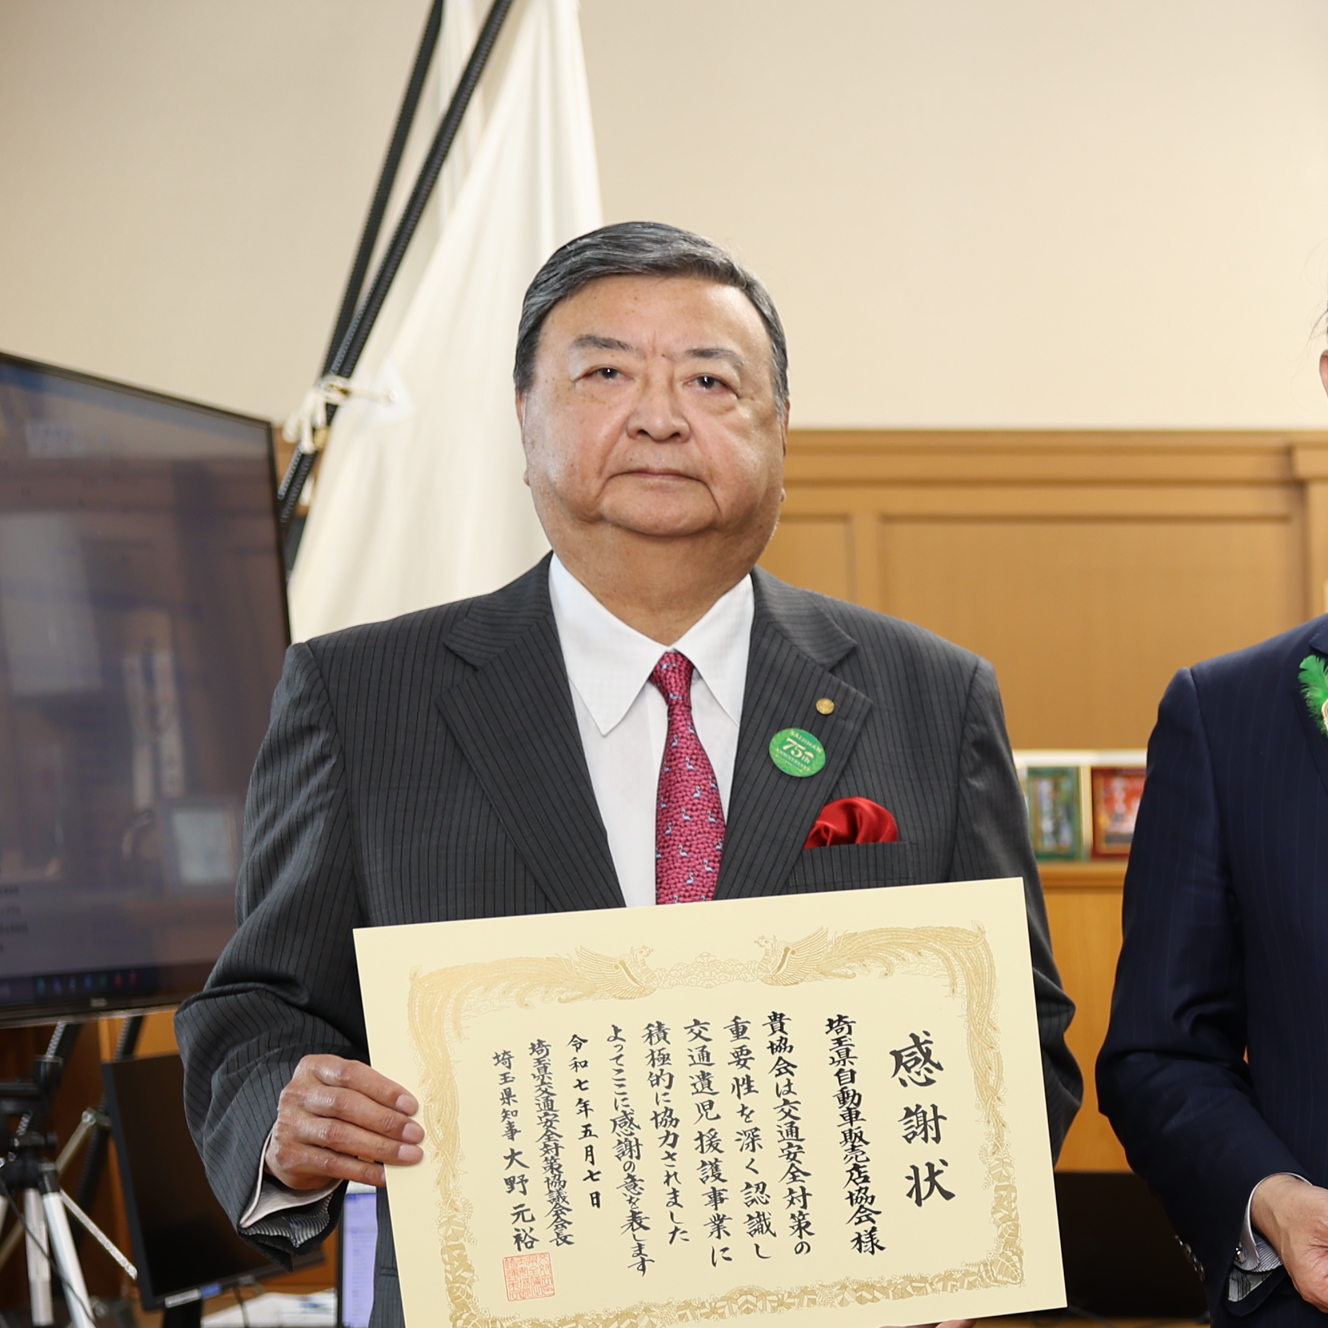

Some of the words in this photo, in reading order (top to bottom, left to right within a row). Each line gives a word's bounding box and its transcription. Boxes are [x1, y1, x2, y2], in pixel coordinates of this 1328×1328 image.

[782, 737, 815, 764] 75th
[492, 1049, 522, 1142] 埼玉県知事
[503, 1147, 540, 1252] 大野元裕
[528, 1038, 575, 1247] 埼玉県交通安全対策協議会会長
[567, 1034, 602, 1209] 令和七年五月七日
[606, 1024, 655, 1277] よってここに感謝の意を表します
[641, 1020, 690, 1245] 積極的に協力されました
[683, 1018, 733, 1268] 交通遺児援護事業に
[723, 1015, 777, 1260] 重要性を深く認識し
[762, 1010, 816, 1255] 貴協会は交通安全対策の
[825, 1013, 886, 1256] 埼玉県自動車販売店協会様
[889, 1030, 956, 1208] 感謝状
